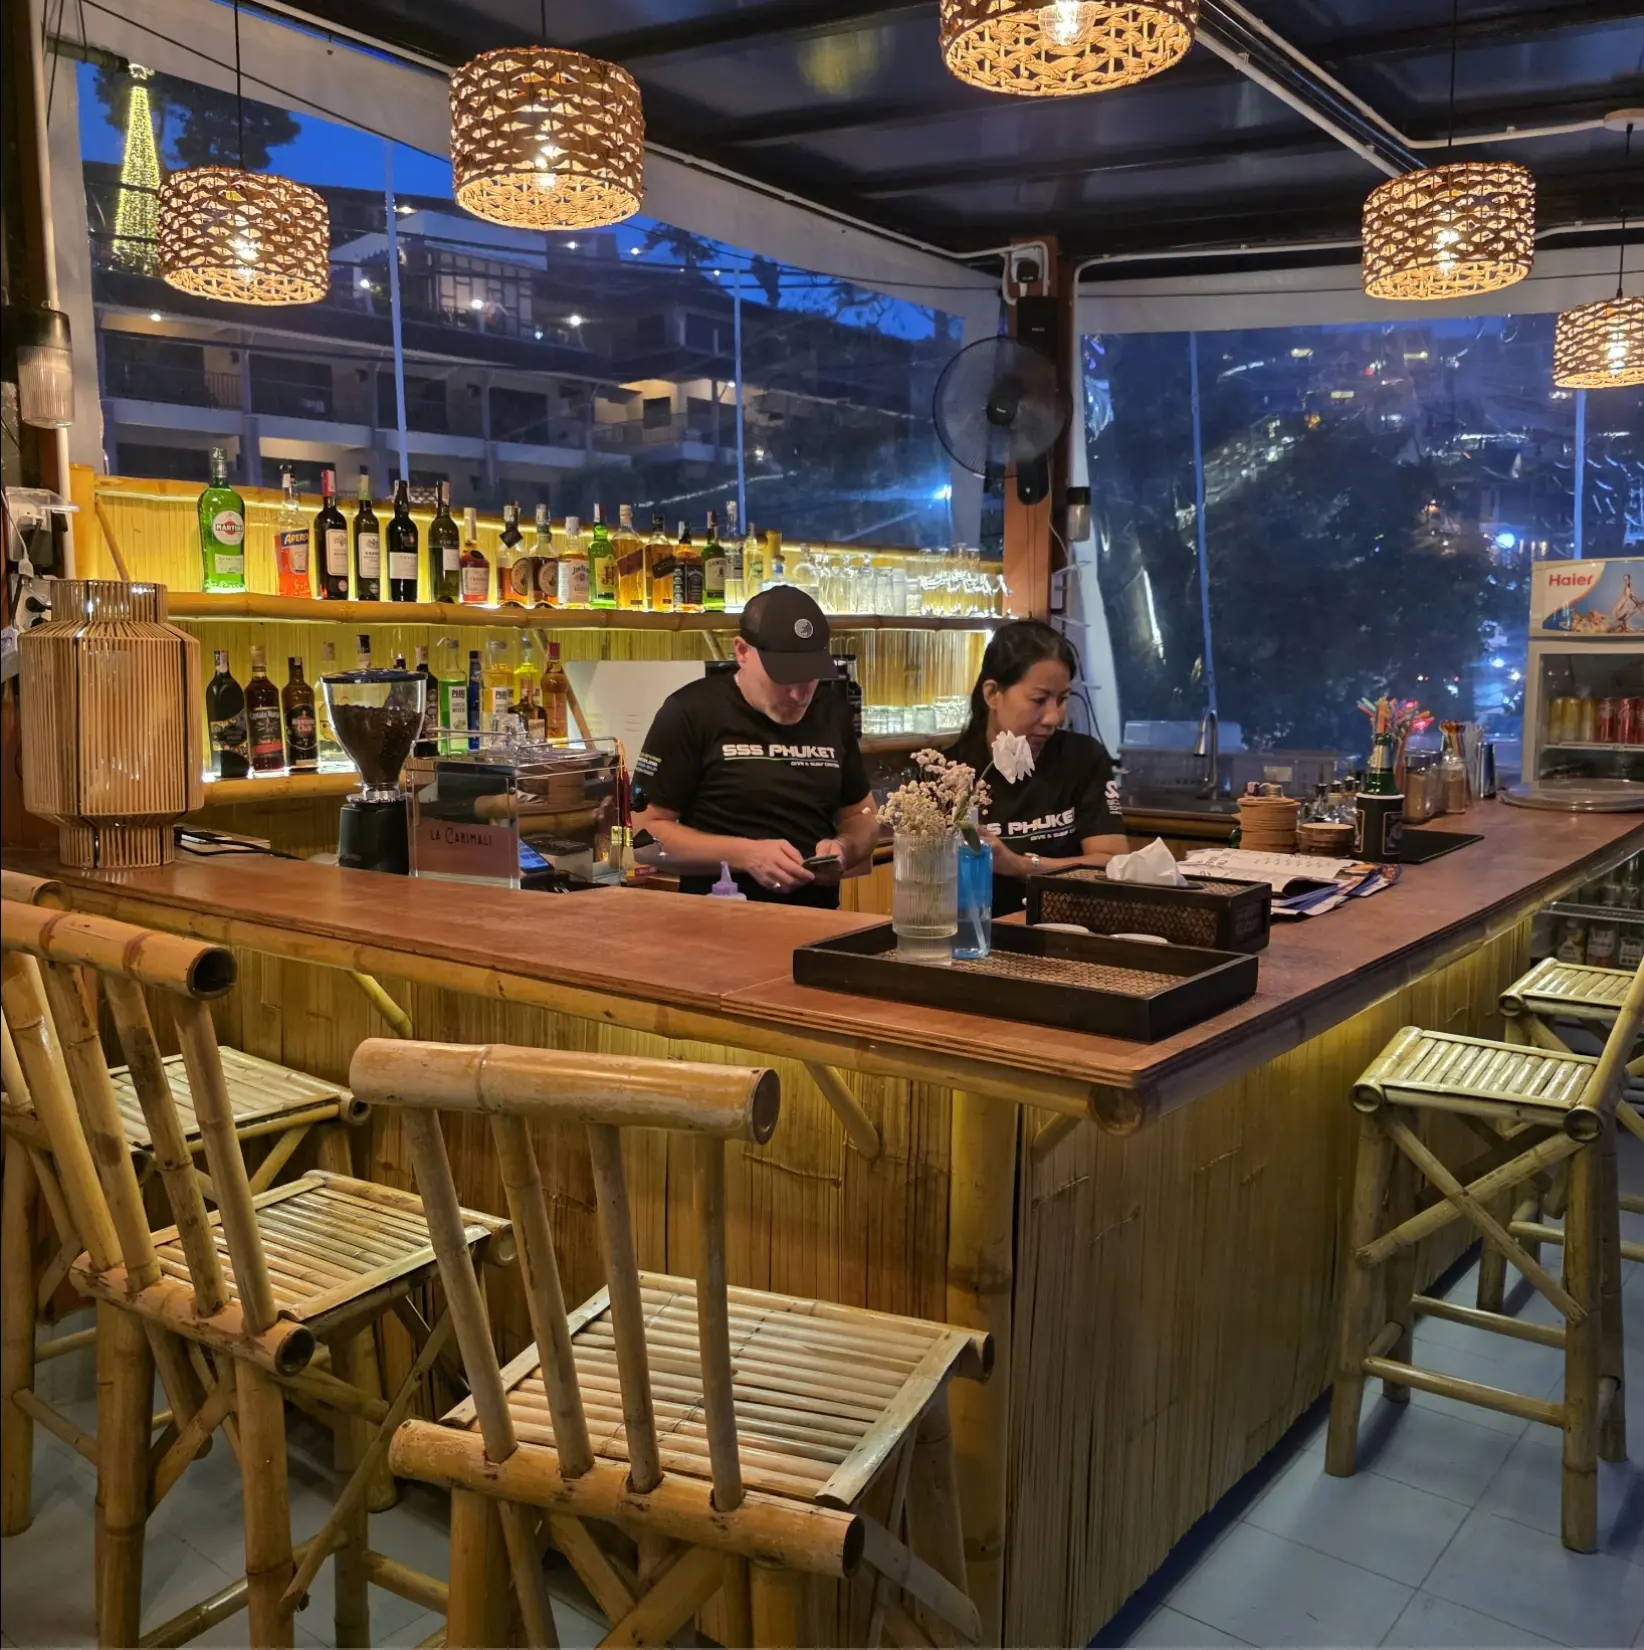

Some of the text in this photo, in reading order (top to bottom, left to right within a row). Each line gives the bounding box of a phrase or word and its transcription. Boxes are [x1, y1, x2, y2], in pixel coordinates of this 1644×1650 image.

[1548, 573, 1594, 587] Haier
[722, 744, 836, 759] SSS PHUKET
[1008, 807, 1076, 836] PHUKE
[430, 829, 441, 841] LA
